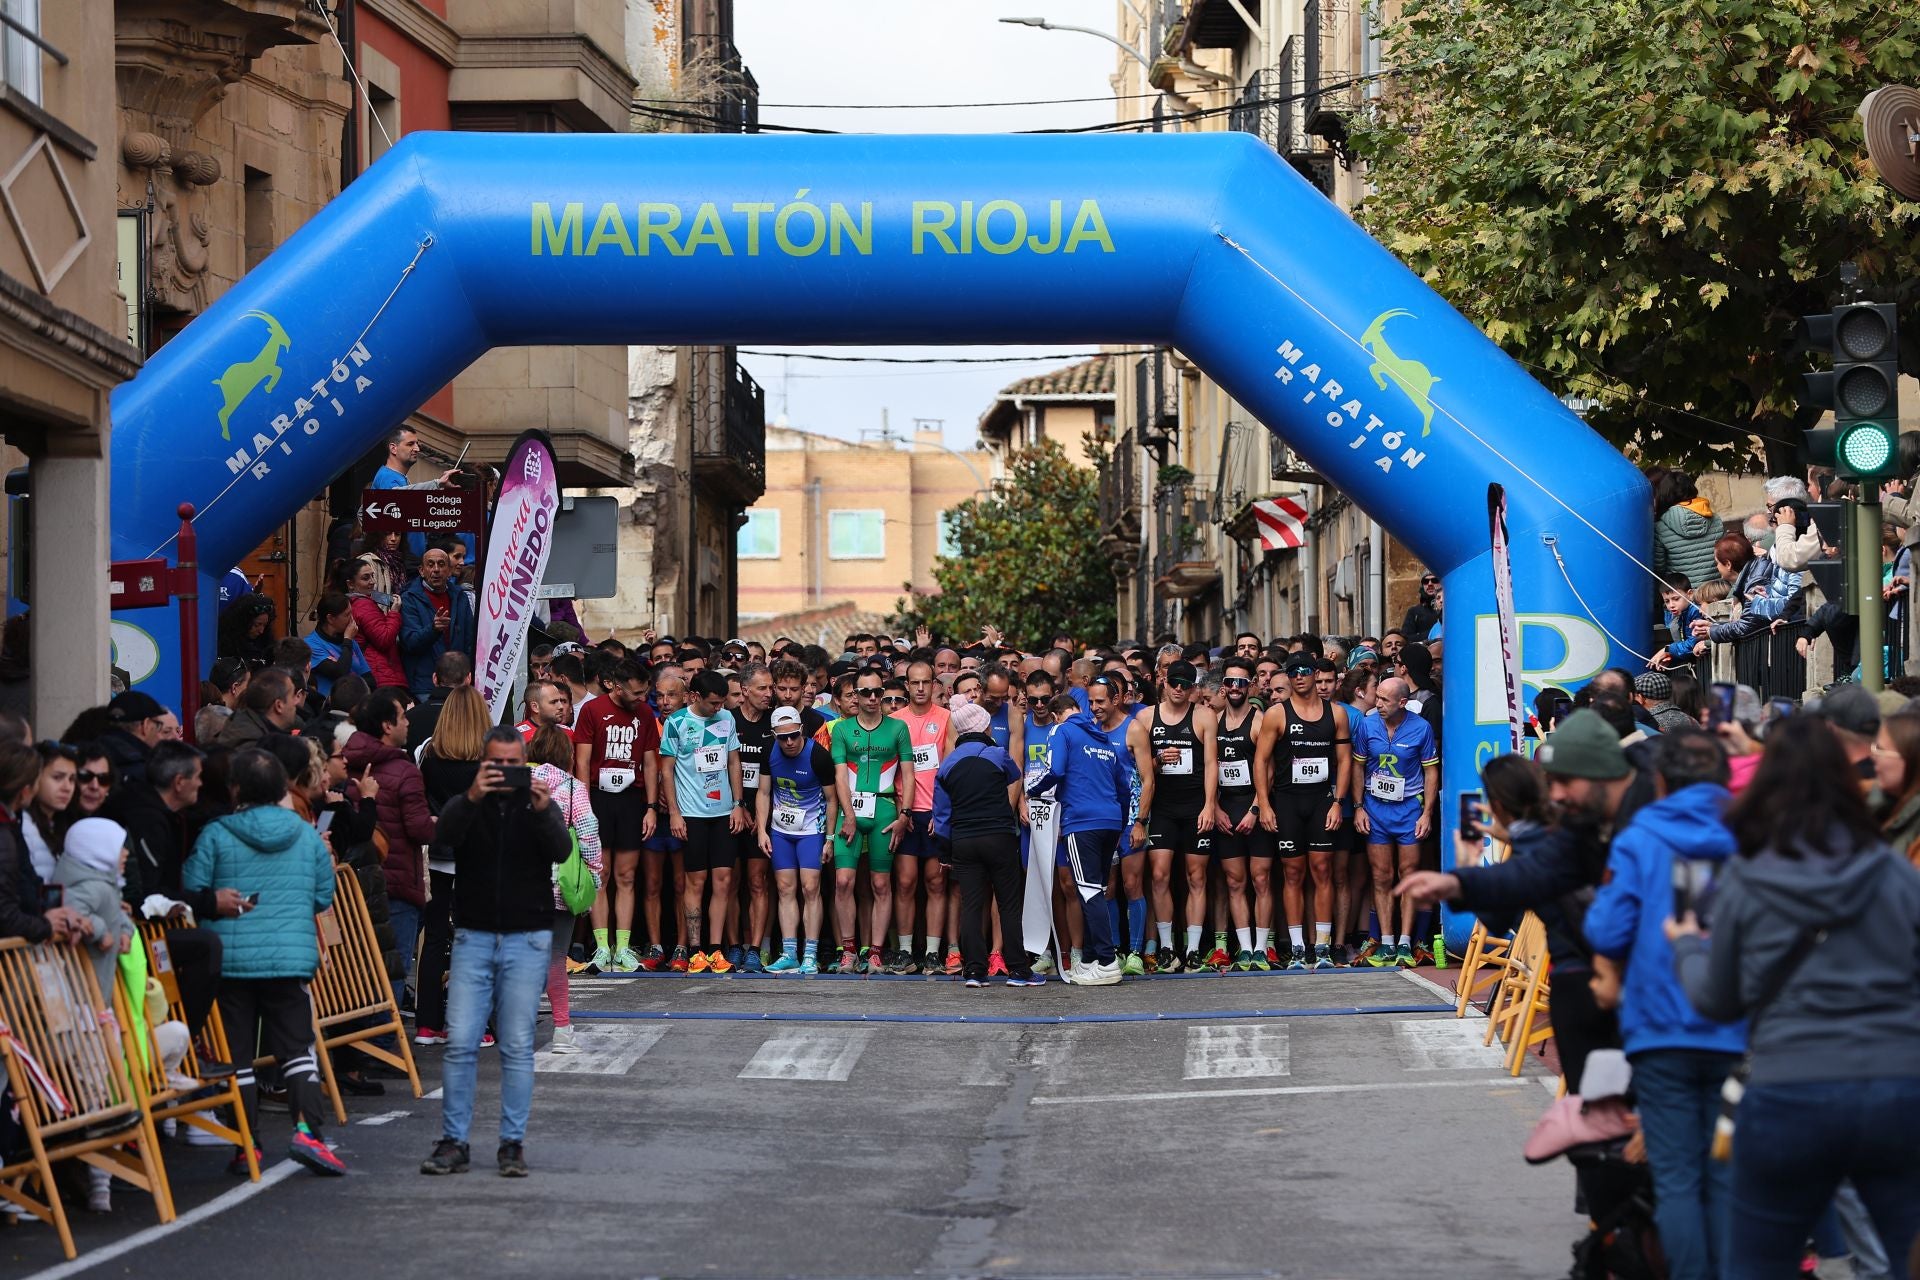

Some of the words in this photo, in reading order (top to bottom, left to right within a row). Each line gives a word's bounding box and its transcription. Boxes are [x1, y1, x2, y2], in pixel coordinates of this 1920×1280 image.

[531, 188, 873, 257] MARATÓN
[911, 198, 1116, 255] RIOJA
[225, 341, 373, 476] MARATÓN
[1276, 339, 1427, 471] MARATÓN
[249, 374, 373, 482] RIOJA
[1273, 367, 1393, 474] RIOJA
[426, 494, 462, 505] Bodega
[429, 506, 461, 516] Calado
[487, 496, 531, 621] Carrera
[502, 649, 517, 679] JOSE
[605, 724, 634, 743] 1010
[605, 742, 633, 760] KMS
[704, 752, 719, 764] 162
[1223, 768, 1241, 778] 693
[1301, 765, 1320, 775] 694
[1379, 753, 1404, 778] R
[611, 774, 624, 785] 68
[1377, 780, 1395, 793] 309
[852, 798, 864, 809] 40
[780, 812, 796, 825] 252
